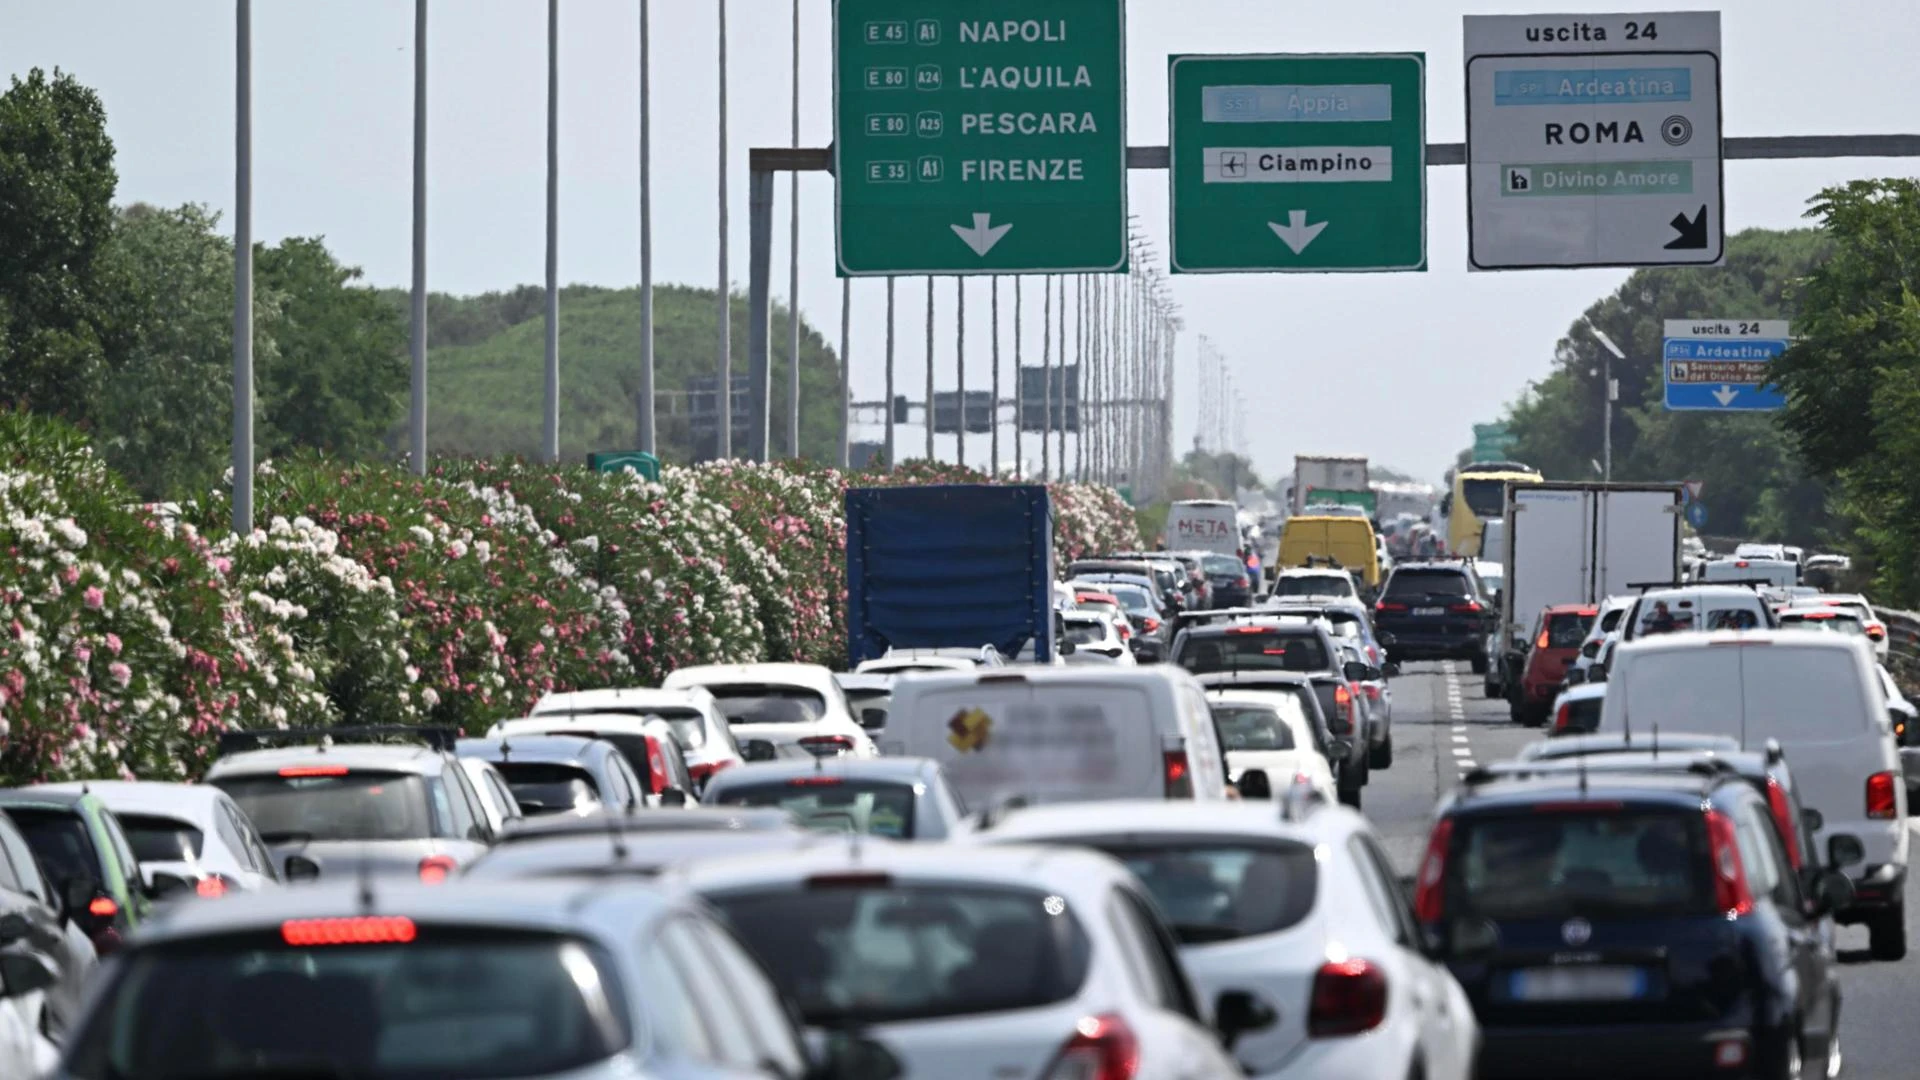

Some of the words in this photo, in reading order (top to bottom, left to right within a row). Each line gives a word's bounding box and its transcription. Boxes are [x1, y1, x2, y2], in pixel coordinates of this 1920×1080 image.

[869, 27, 879, 39] E
[885, 26, 903, 39] 45
[920, 25, 936, 40] A1
[959, 20, 1066, 42] NAPOLI
[1526, 22, 1607, 42] uscita
[1625, 22, 1658, 41] 24
[869, 71, 879, 84] E
[886, 71, 903, 84] 80
[918, 70, 939, 84] A24
[960, 65, 1092, 89] L'AQUILA
[1559, 77, 1675, 96] Ardeatina
[1288, 94, 1349, 114] Appia
[870, 119, 880, 131] E
[887, 119, 904, 131] 80
[919, 118, 941, 131] A25
[961, 112, 1098, 135] PESCARA
[1545, 121, 1645, 145] ROMA
[871, 166, 881, 178] E
[888, 166, 905, 179] 35
[922, 161, 938, 177] A1
[961, 159, 1084, 181] FIRENZE
[1259, 153, 1373, 174] Ciampino
[1543, 171, 1608, 188] Divino
[1613, 170, 1680, 187] Amore
[1692, 324, 1731, 335] uscita
[1739, 322, 1760, 335] 24
[1696, 345, 1771, 357] Ardeatina
[1178, 519, 1228, 534] META
